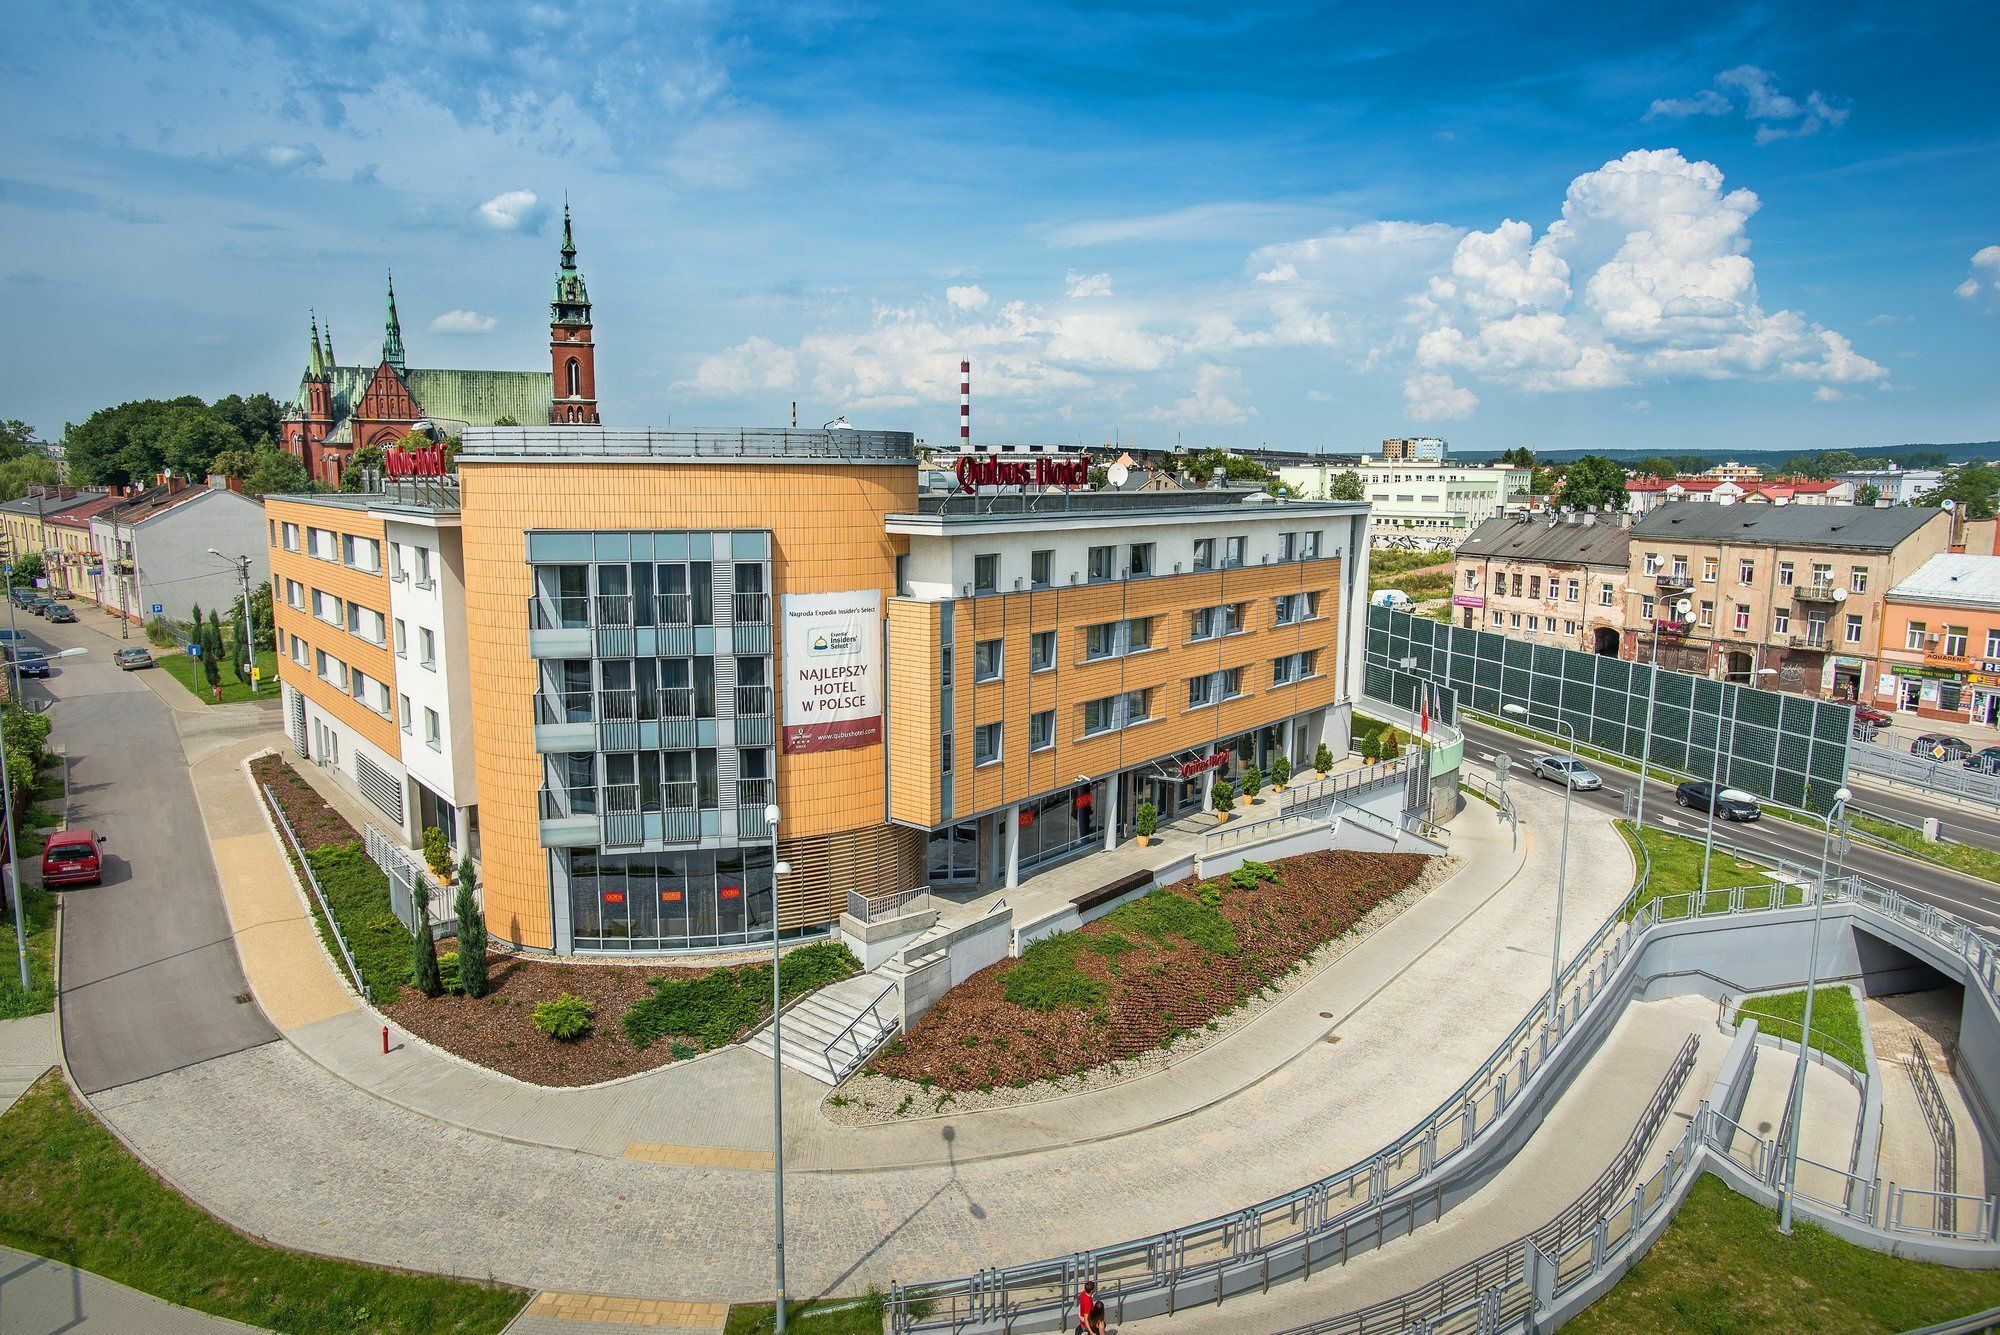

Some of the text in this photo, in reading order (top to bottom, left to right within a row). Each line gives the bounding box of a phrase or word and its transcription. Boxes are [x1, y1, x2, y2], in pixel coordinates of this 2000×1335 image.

[955, 453, 1093, 494] Qubus Hotel
[789, 610, 814, 618] Nagroda
[1927, 653, 1966, 663] AQUADENT
[800, 665, 868, 681] NAJLEPSZY
[814, 682, 857, 695] HOTEL
[802, 695, 866, 711] W POLSCE
[817, 728, 877, 740] www.qubushotel.com
